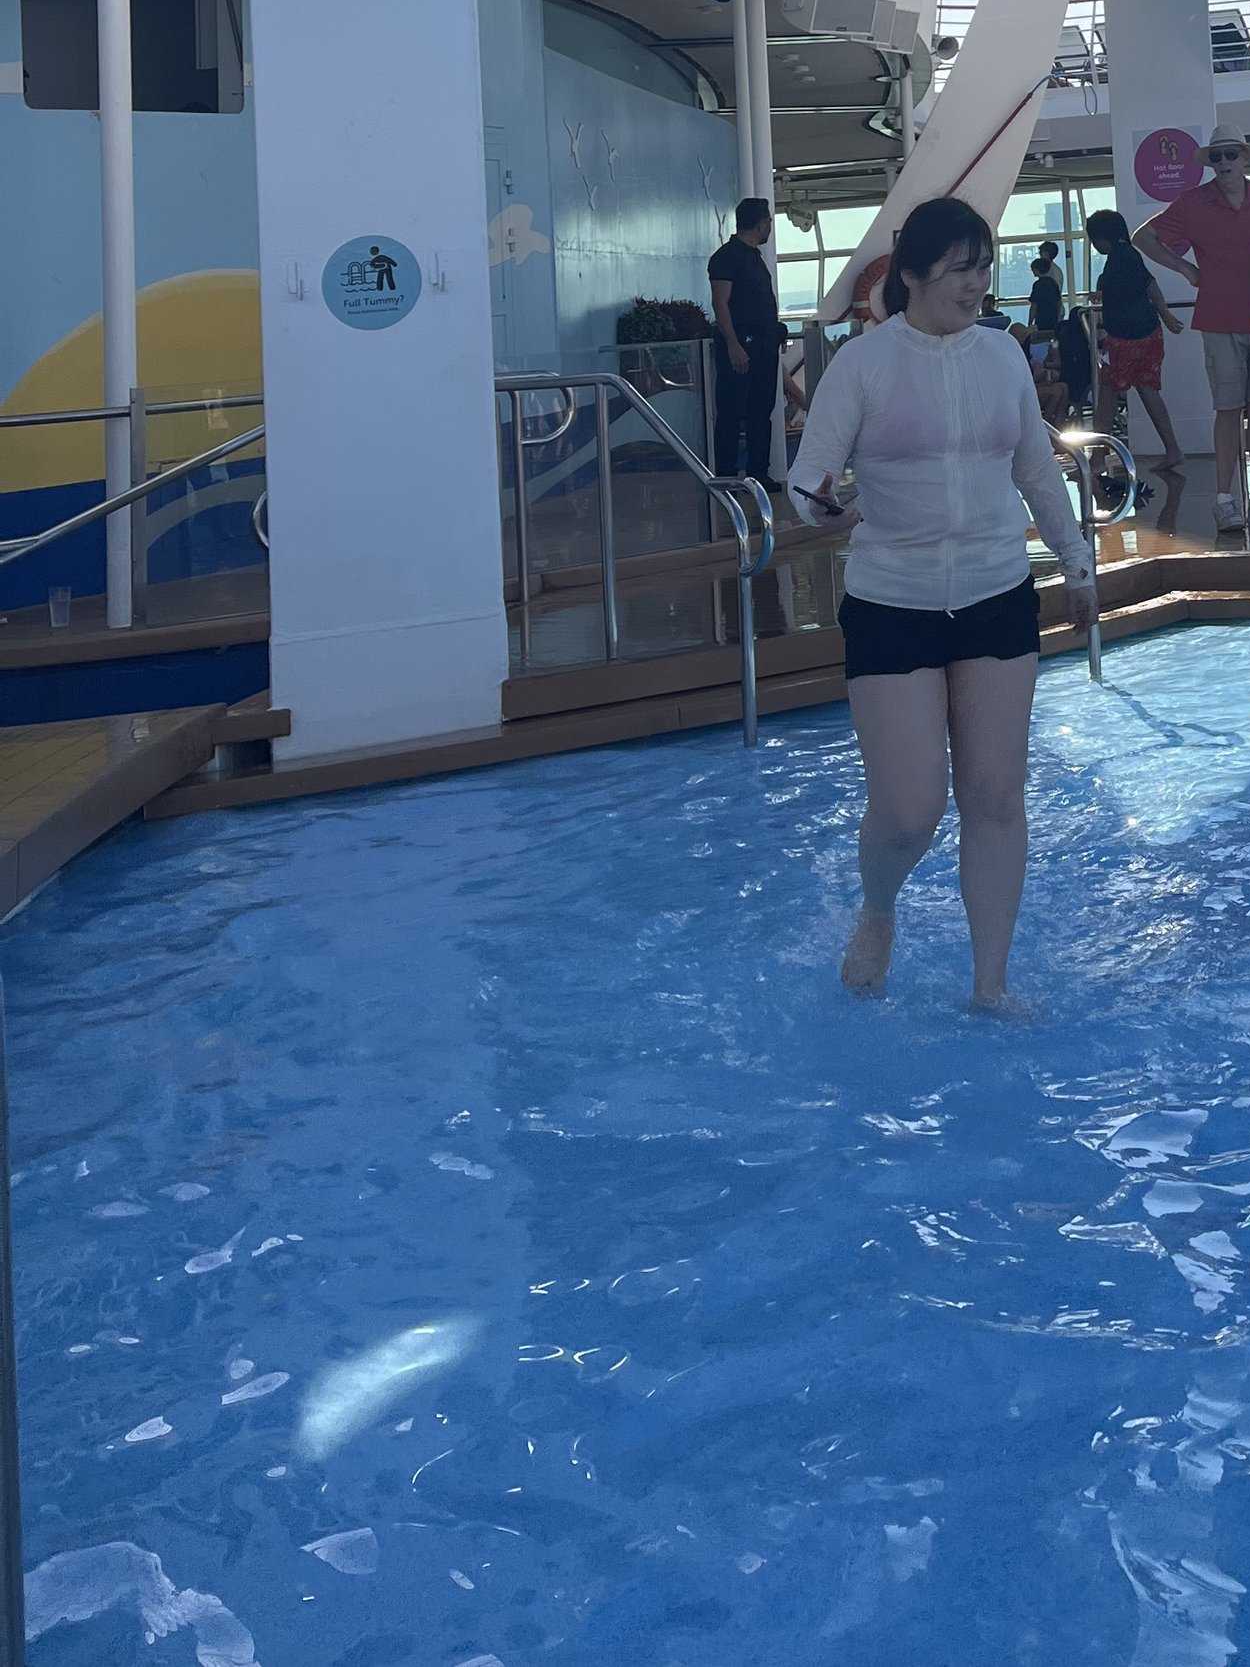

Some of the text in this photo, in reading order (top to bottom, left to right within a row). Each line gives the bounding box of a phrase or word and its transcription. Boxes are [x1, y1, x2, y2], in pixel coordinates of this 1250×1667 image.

[1153, 163, 1185, 172] Hot floor
[343, 294, 405, 308] Full Tummy?
